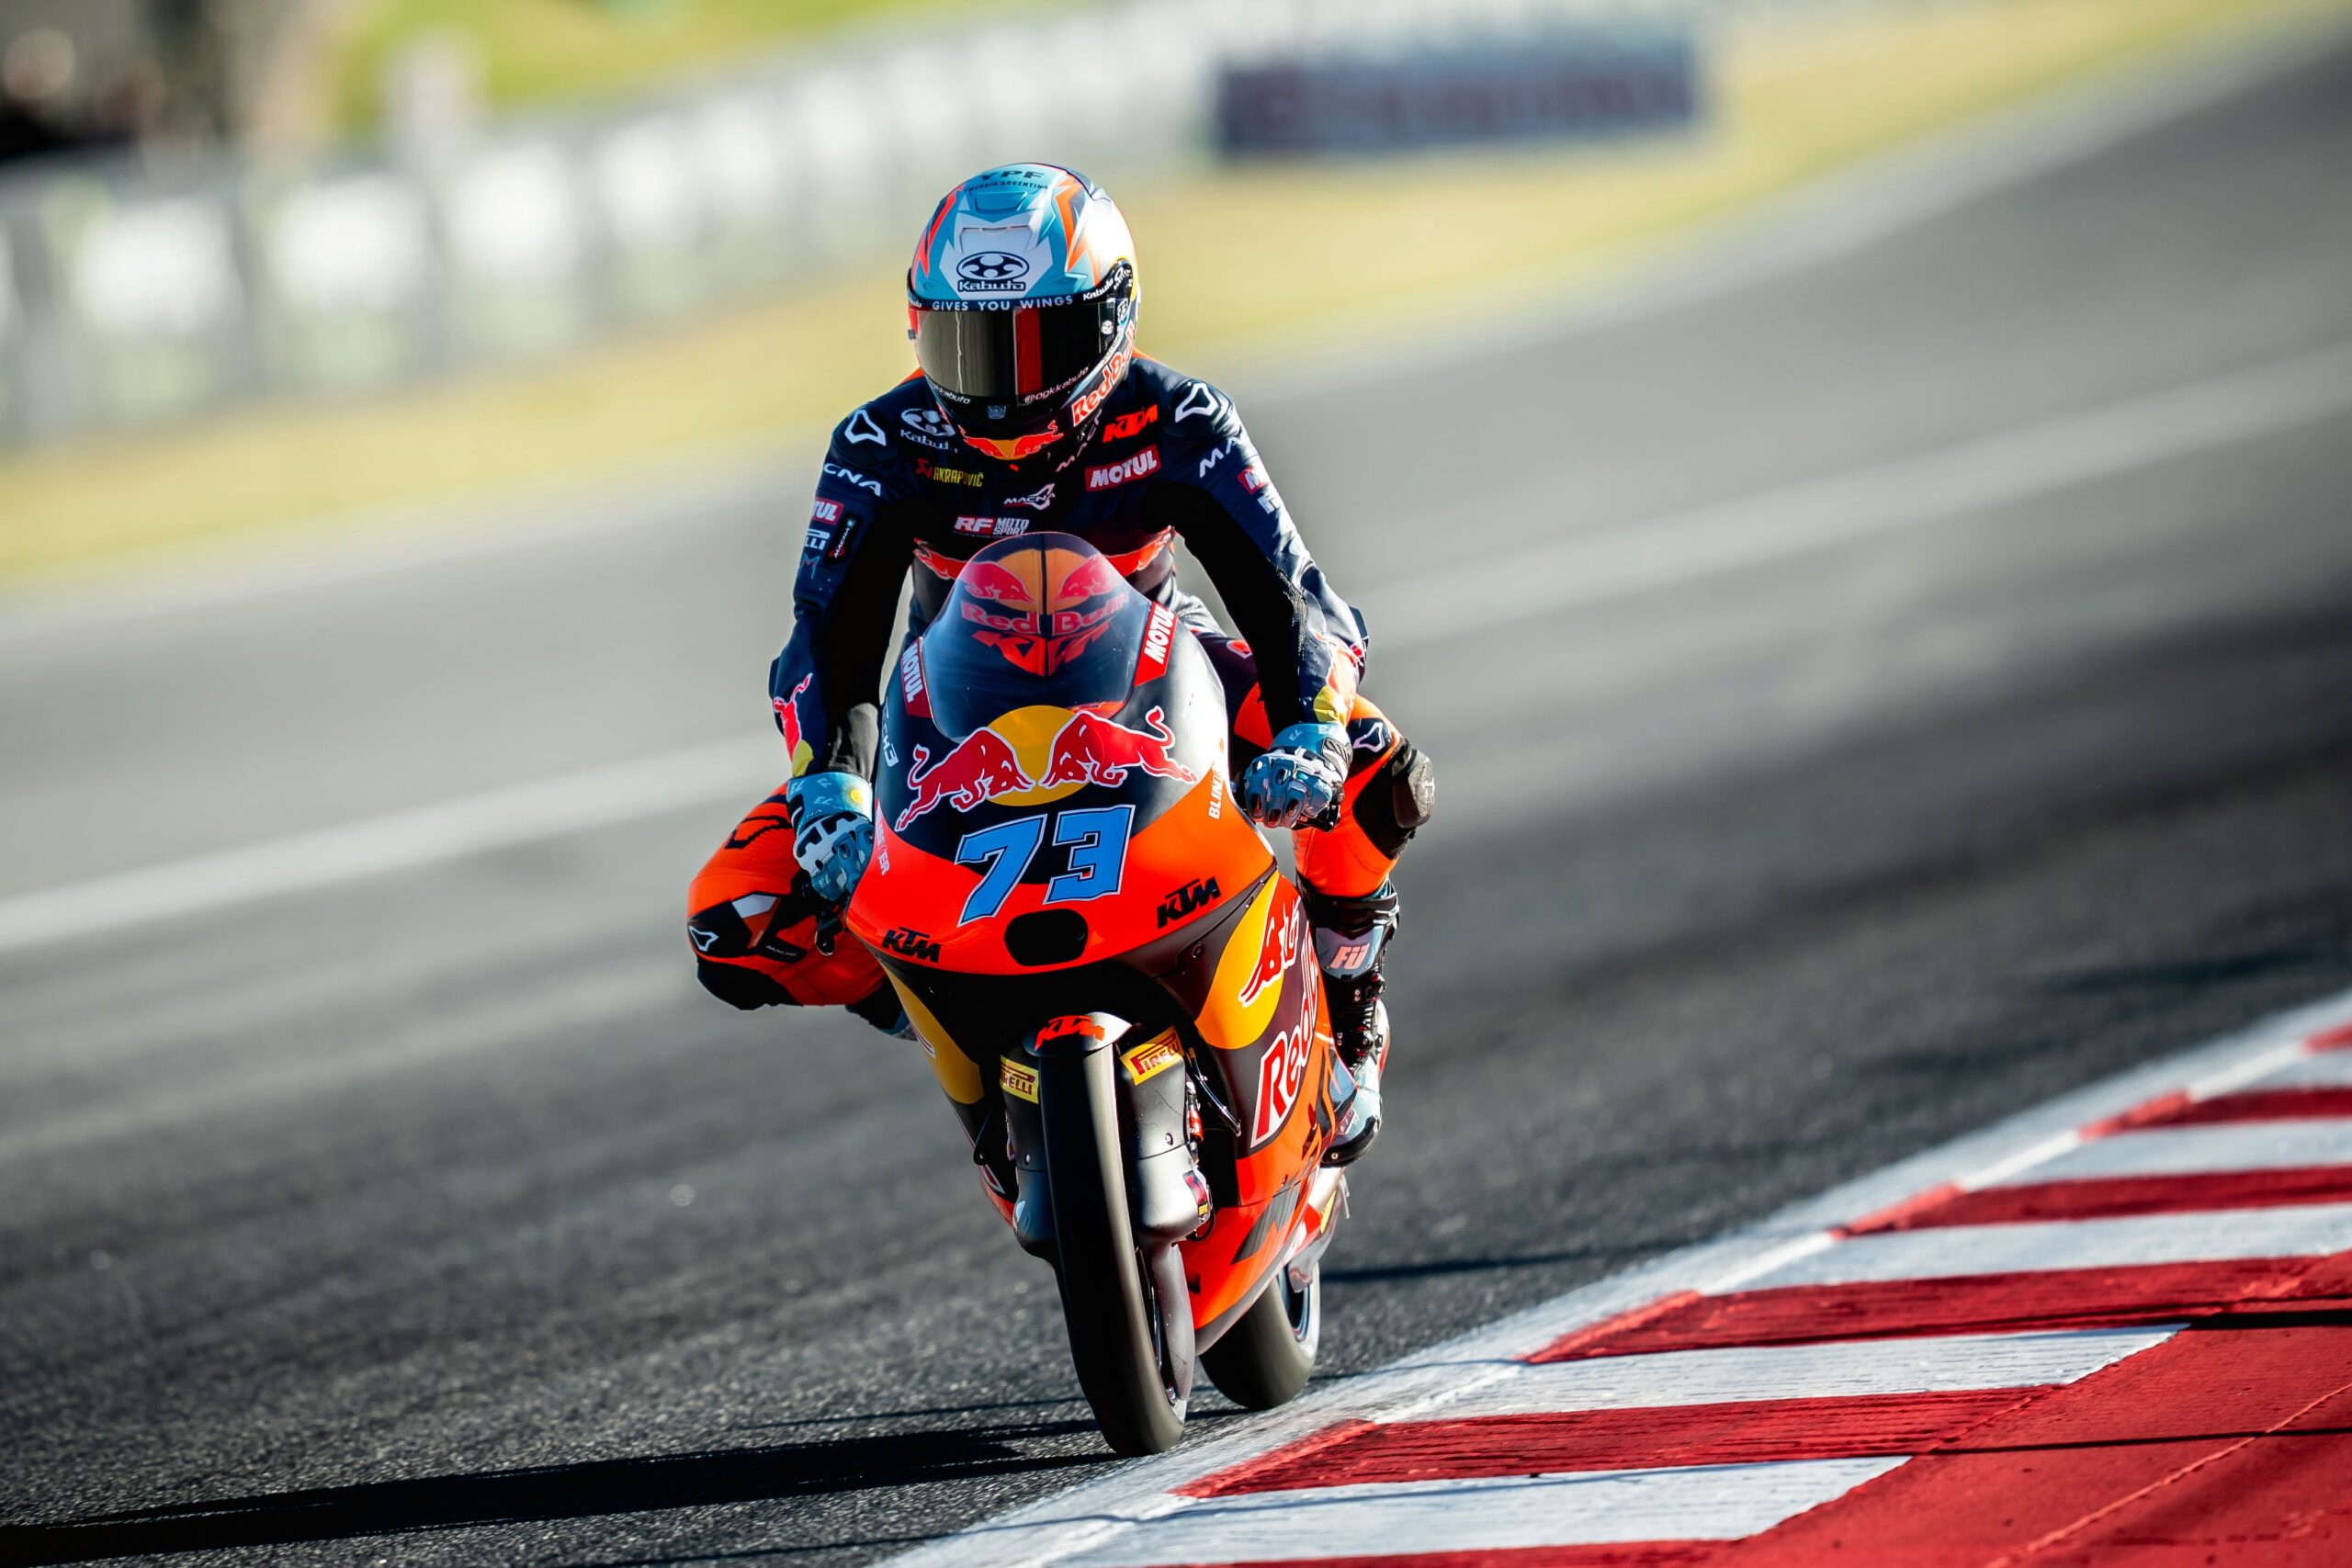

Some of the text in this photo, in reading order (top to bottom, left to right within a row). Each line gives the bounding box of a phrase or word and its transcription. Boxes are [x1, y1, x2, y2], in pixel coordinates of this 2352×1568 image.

[979, 170, 1045, 182] YPF
[1000, 180, 1048, 190] ARGENTINA
[933, 296, 1073, 311] GIVES YOU WINGS
[958, 279, 1025, 292] Kabuto
[1083, 277, 1114, 301] Kabuto
[1071, 365, 1113, 427] Red
[1102, 404, 1159, 443] KTM
[823, 462, 881, 497] CNA
[1090, 449, 1158, 489] MOTUL
[1003, 491, 1056, 505] MACNA
[954, 516, 1030, 533] RF MOTO
[960, 591, 1130, 637] Red Bull
[1144, 604, 1176, 665] MOTUL
[901, 642, 924, 704] MOTUL
[955, 805, 1136, 928] 73
[1157, 876, 1222, 930] KTM
[882, 927, 942, 963] KTM
[1035, 1014, 1105, 1051] KTM
[1250, 937, 1313, 1149] Red
